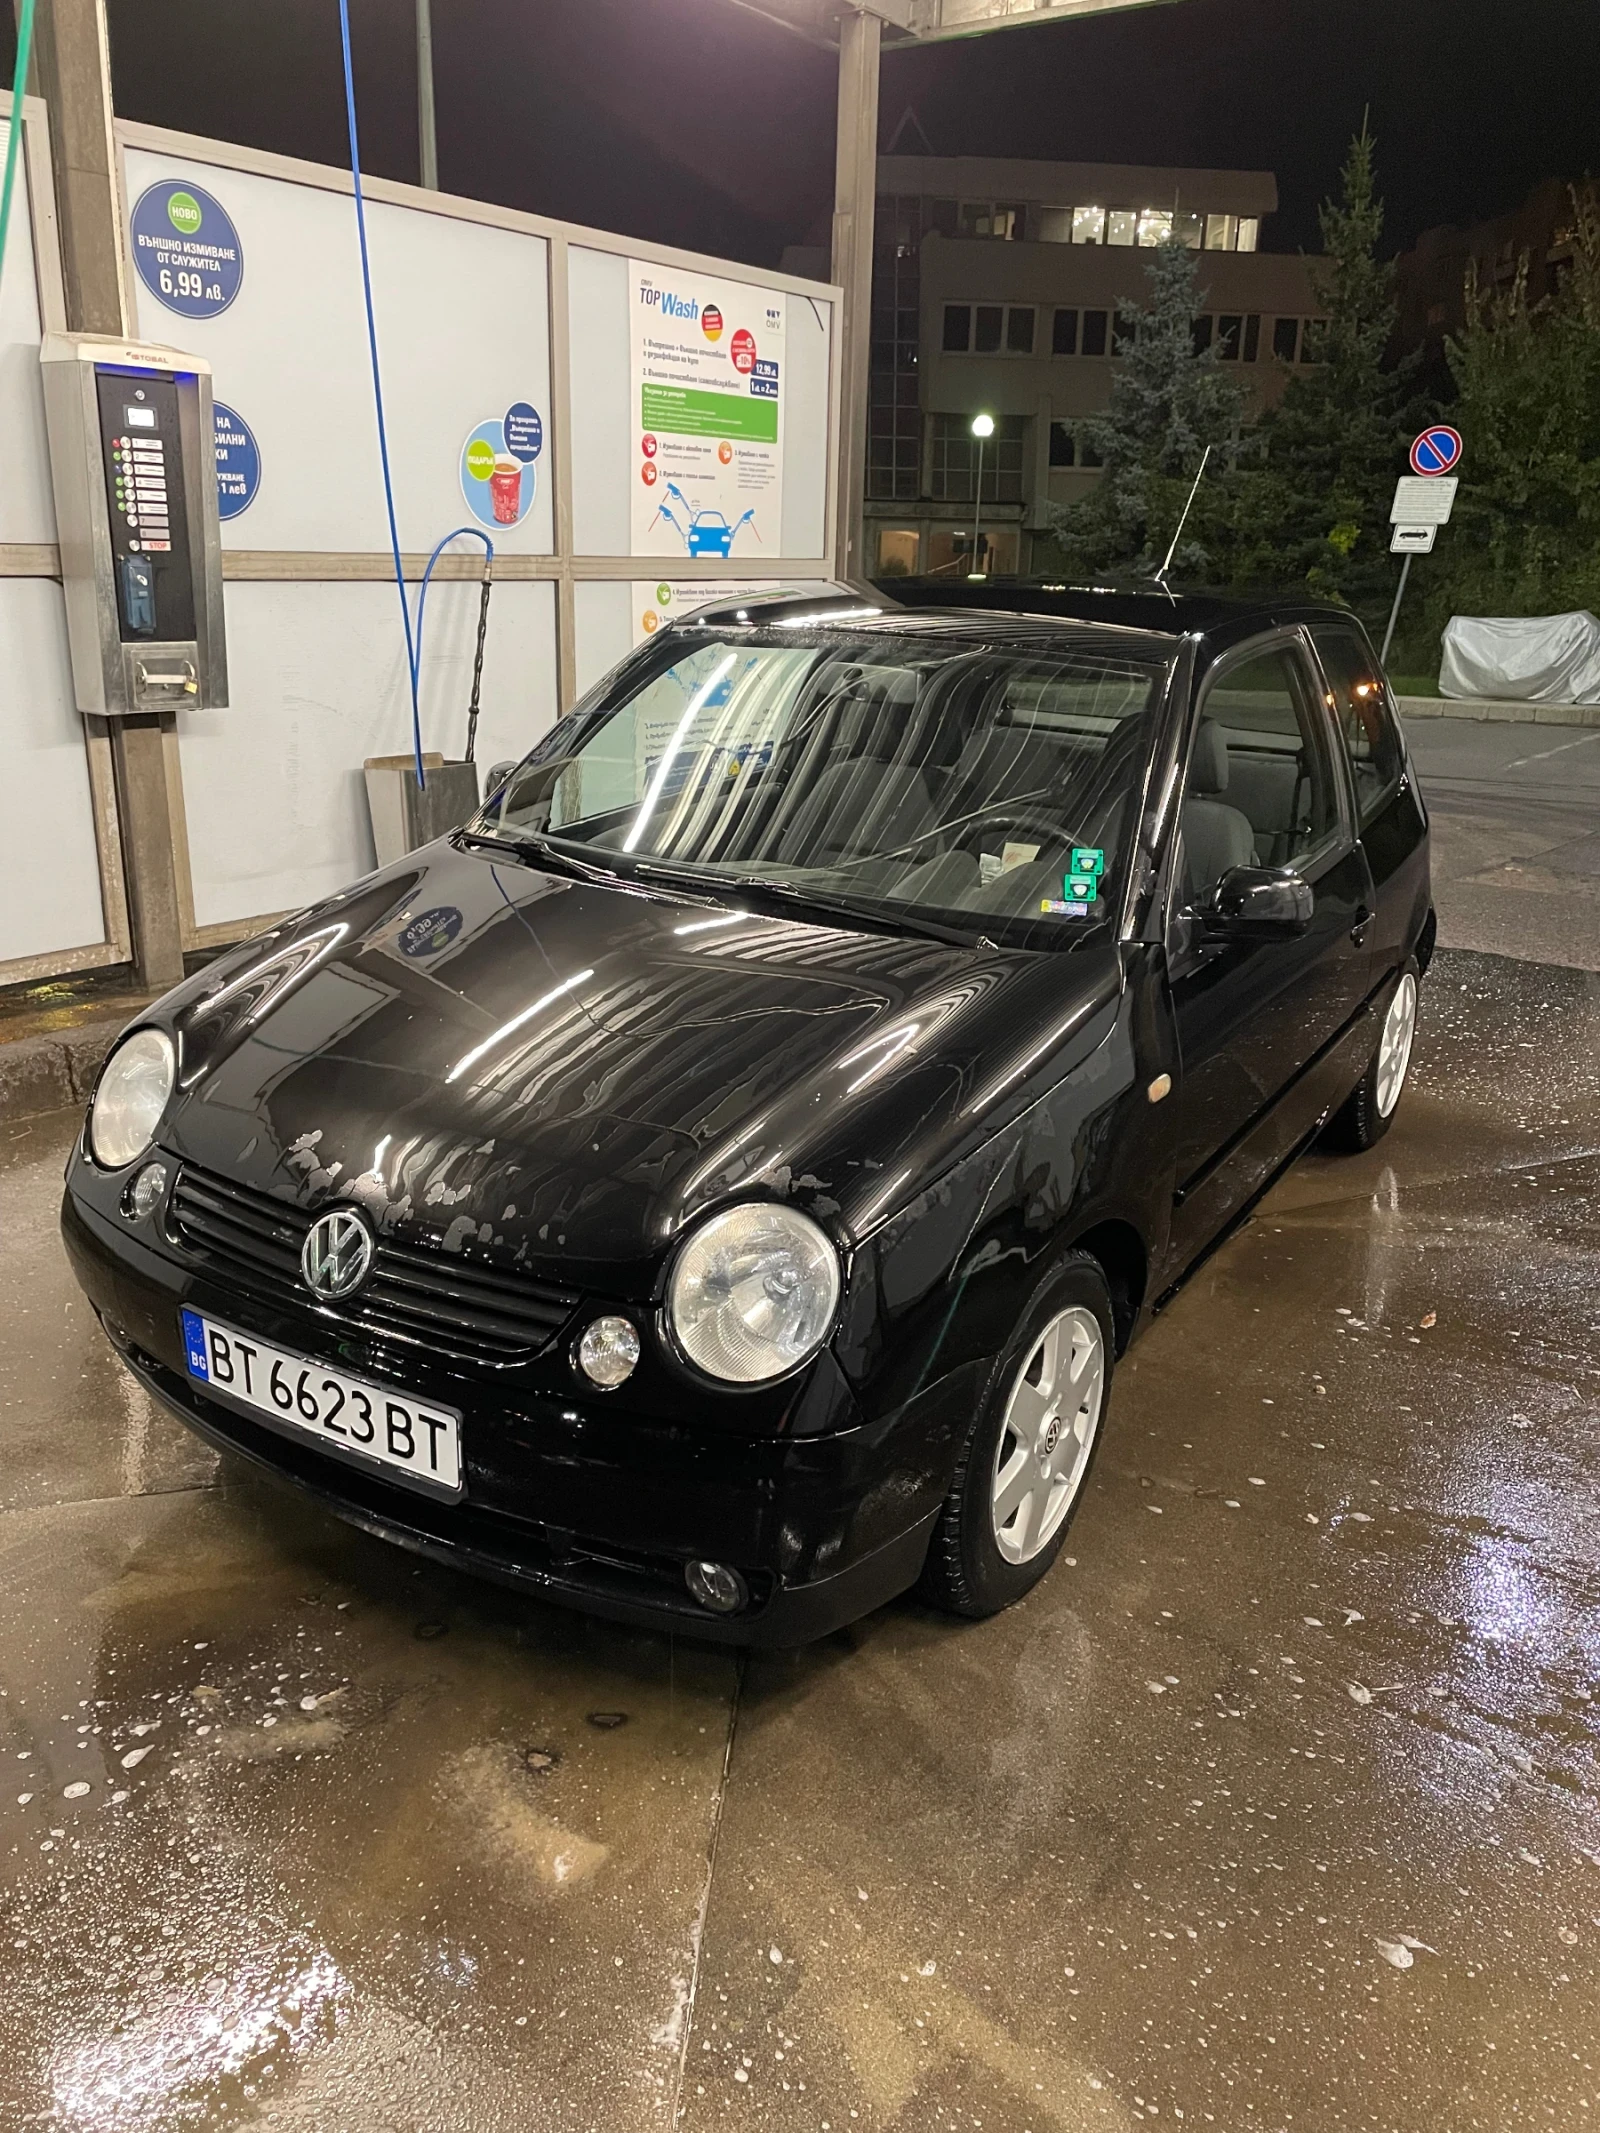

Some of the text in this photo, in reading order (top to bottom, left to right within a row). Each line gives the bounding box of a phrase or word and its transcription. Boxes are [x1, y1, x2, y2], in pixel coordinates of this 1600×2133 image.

[172, 206, 198, 220] НОВО
[138, 234, 236, 260] ВЪНШНО ИЗМИВАНЕ
[157, 252, 221, 272] ОТ СЛУЖИТЕЛ
[159, 269, 226, 301] 6,99 лв.
[766, 319, 780, 329] OMV
[216, 416, 231, 429] НА
[221, 482, 247, 495] 1 лев
[190, 1351, 207, 1371] BG
[208, 1328, 448, 1472] BT 6623 BT
